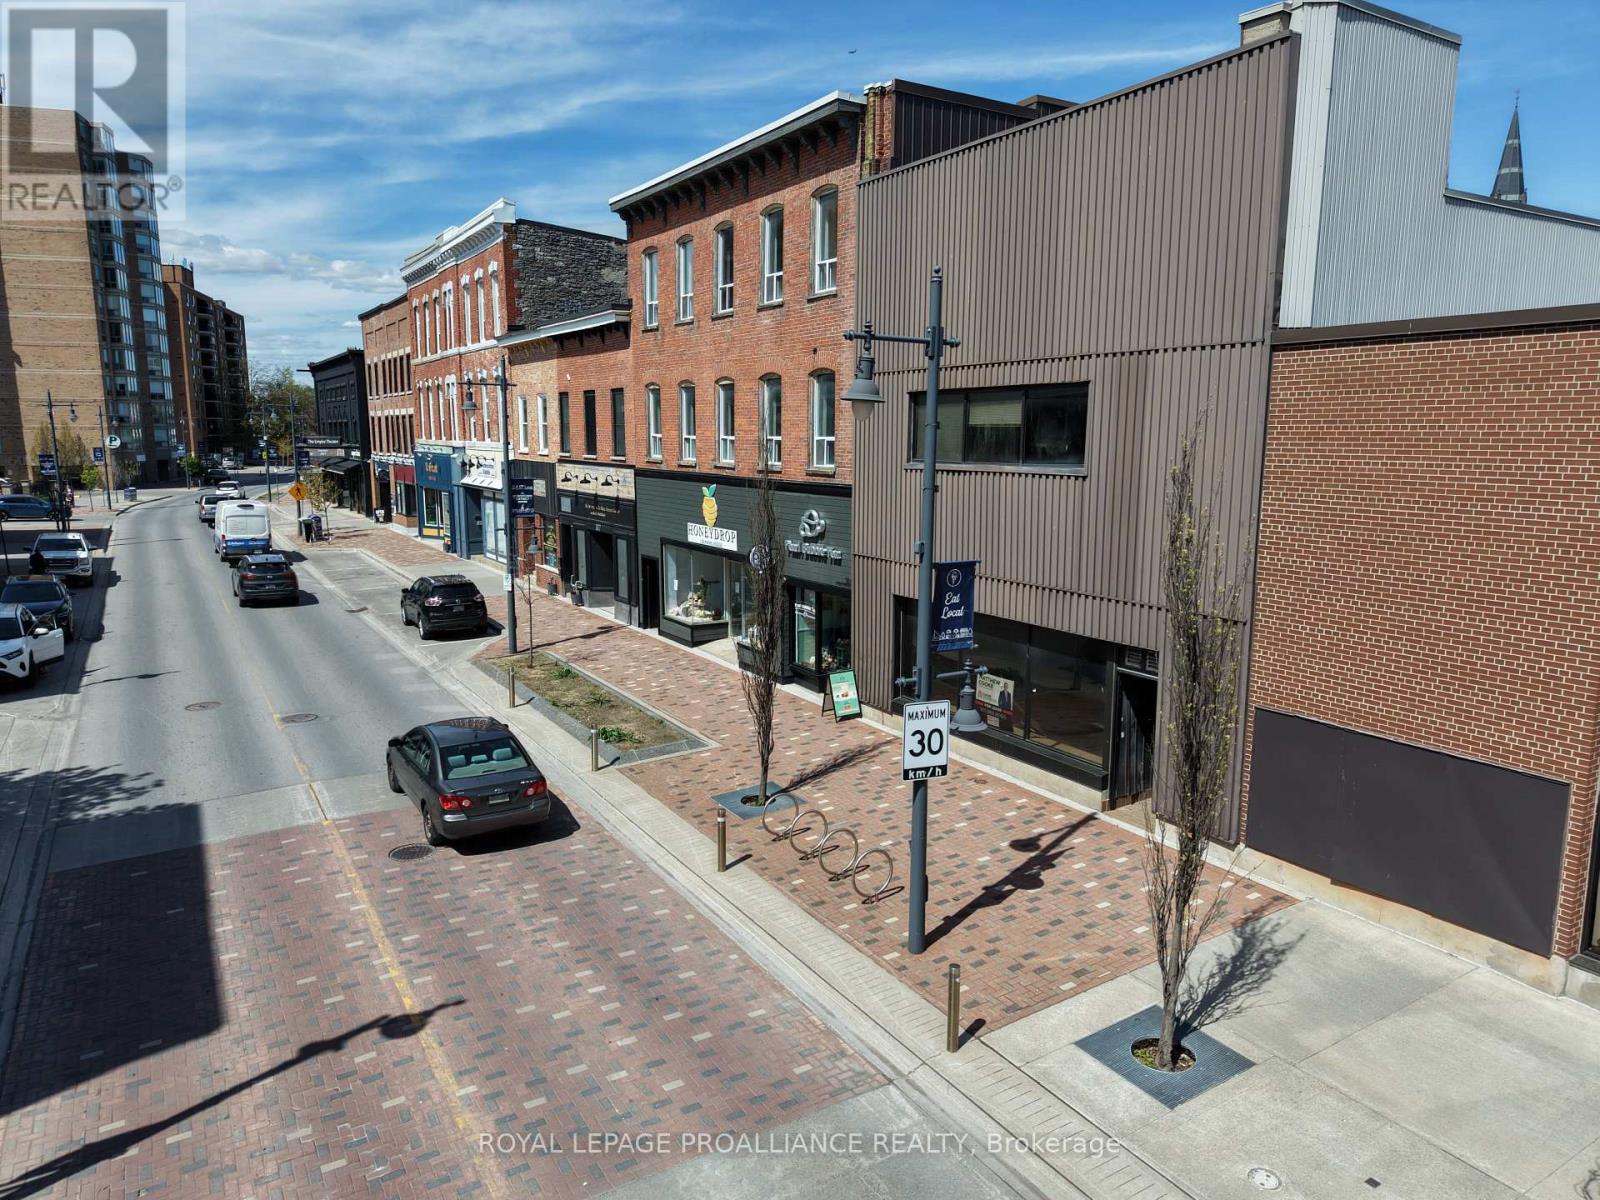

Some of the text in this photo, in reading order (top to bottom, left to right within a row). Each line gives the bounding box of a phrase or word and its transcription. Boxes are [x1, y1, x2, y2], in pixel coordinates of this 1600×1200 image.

[108, 436, 118, 445] P
[688, 524, 736, 543] HONEYDROP
[944, 591, 961, 605] Eat
[940, 605, 965, 619] Local
[907, 707, 946, 721] MAXIMUM
[908, 727, 944, 758] 30
[908, 766, 942, 780] km/h
